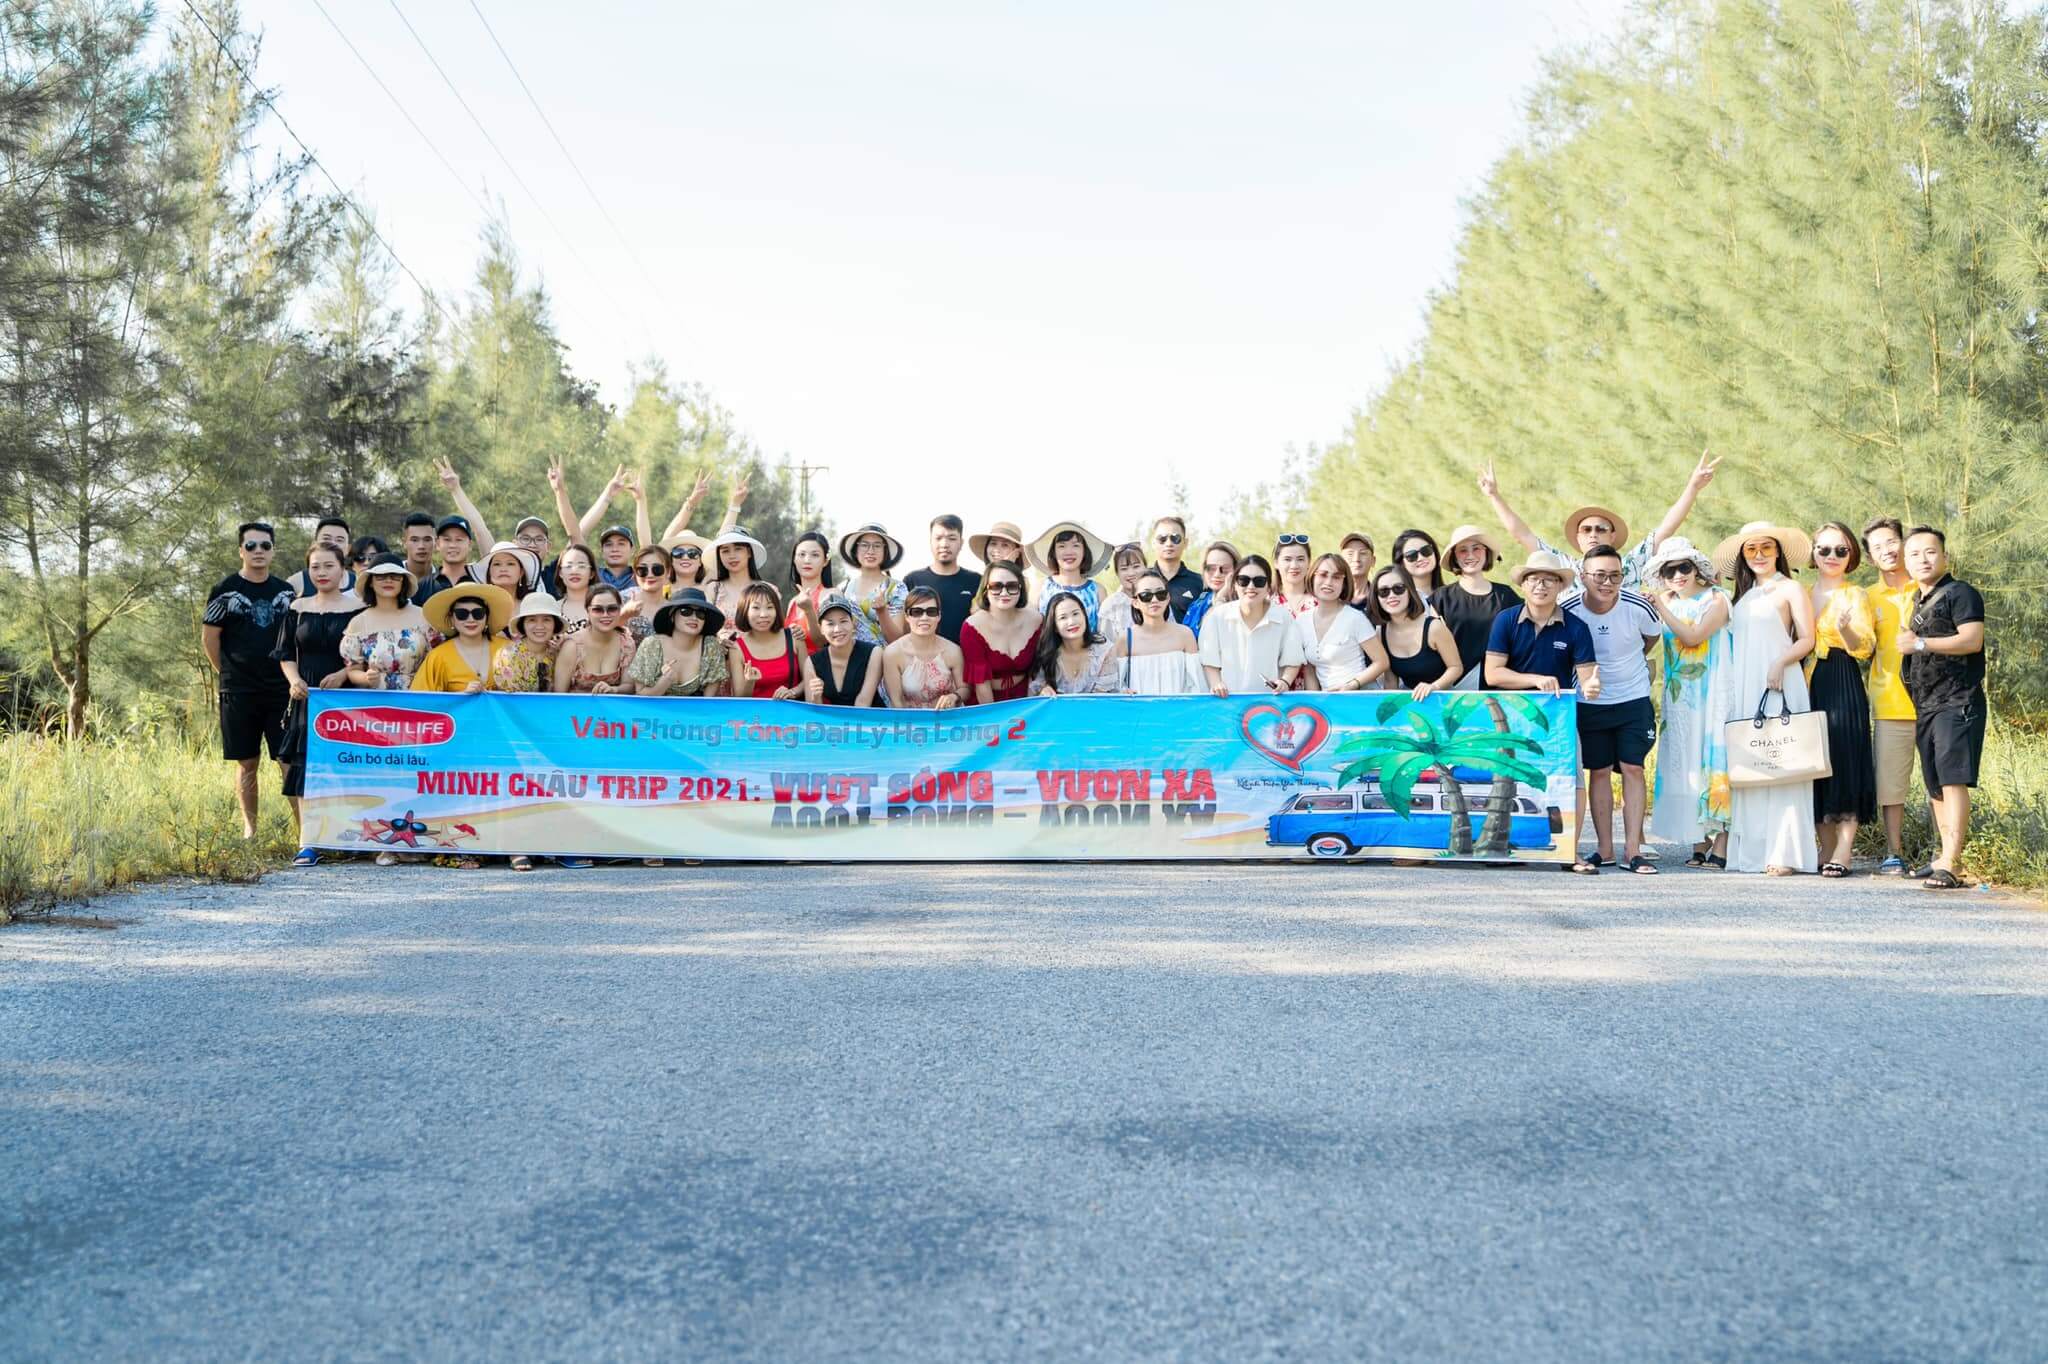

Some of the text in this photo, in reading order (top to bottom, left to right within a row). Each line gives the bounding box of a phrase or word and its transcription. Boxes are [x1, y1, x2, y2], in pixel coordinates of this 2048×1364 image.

[326, 719, 445, 735] DAI-ICHI LIFE
[570, 715, 626, 740] Văn
[630, 717, 722, 748] Phòng
[727, 714, 799, 749] Tổng
[855, 720, 888, 749] Lý
[893, 720, 928, 747] Hạ
[933, 720, 1000, 747] Long
[1007, 717, 1027, 741] 2
[1750, 736, 1798, 748] CHANEL
[416, 771, 500, 797] MINH
[508, 769, 589, 798] CHÂU
[596, 775, 668, 801] TRIP
[678, 776, 761, 802] 2021:
[887, 766, 994, 804] SÓNG
[1161, 768, 1217, 801] XA
